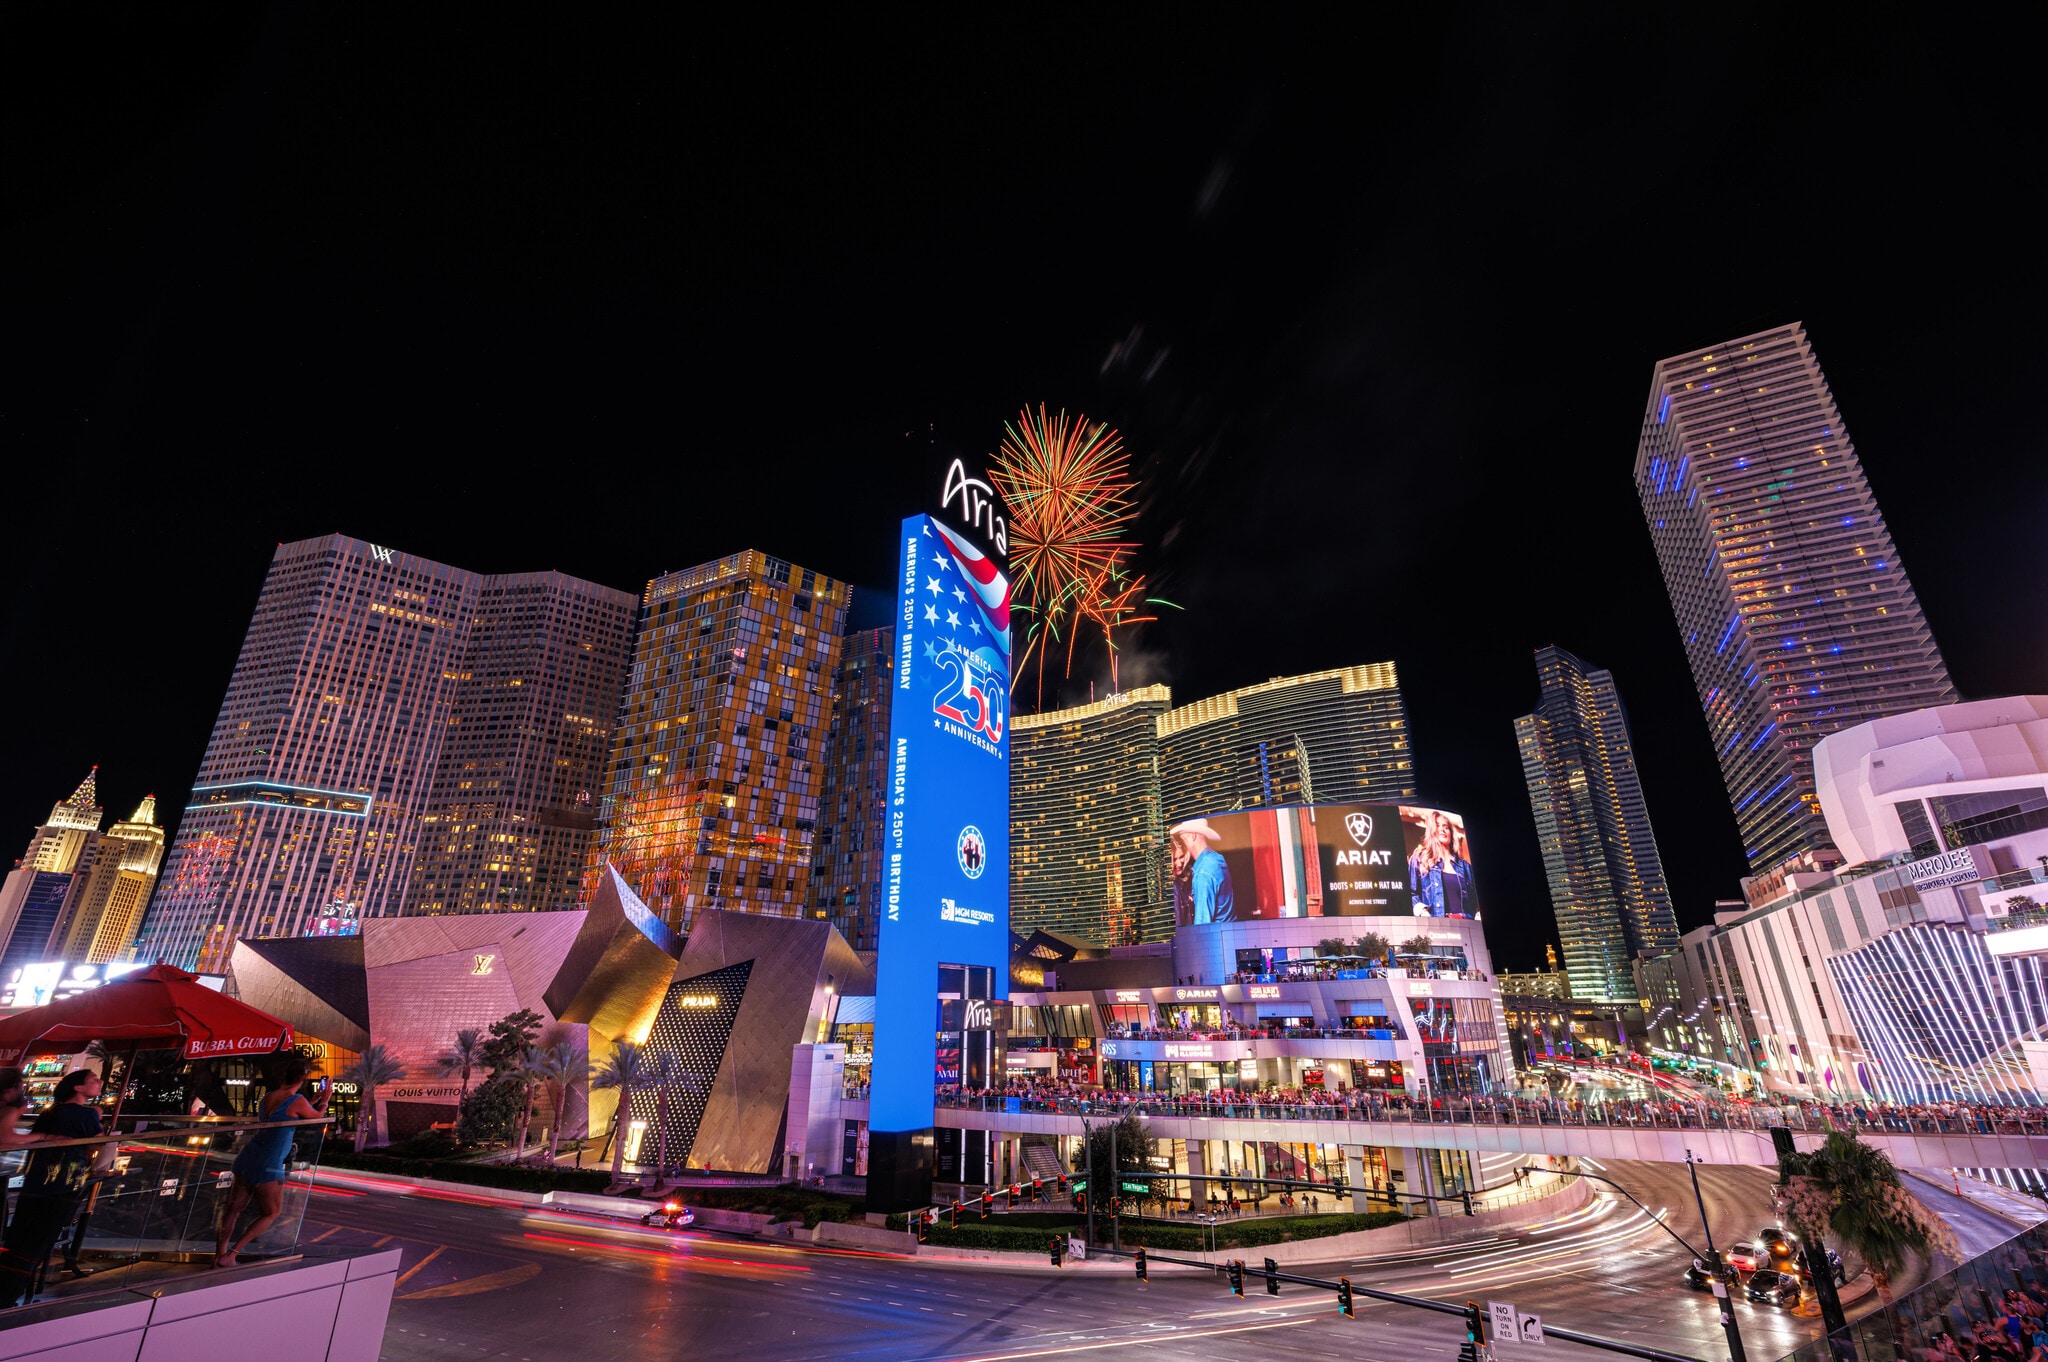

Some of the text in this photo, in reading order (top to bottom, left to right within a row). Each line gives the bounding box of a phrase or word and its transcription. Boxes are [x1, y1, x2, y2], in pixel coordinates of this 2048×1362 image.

[943, 459, 1007, 556] Aria
[905, 537, 917, 595] AMERICA'S
[900, 634, 912, 689] BIRTHDAY
[957, 643, 992, 673] AMERICA
[933, 650, 1004, 743] 250
[1104, 693, 1128, 709] Aria
[944, 721, 998, 757] ANNIVERSARY
[894, 738, 907, 806] AMERICA'S
[1336, 850, 1392, 866] ARIAT
[1907, 848, 1973, 880] MARQUEE
[888, 854, 901, 921] BIRTHDAY
[1329, 882, 1403, 891] BOOTS DENIM HAT BAR
[955, 907, 970, 918] MGM
[970, 909, 994, 923] RESORTS
[682, 996, 717, 1007] PRADA
[1187, 989, 1218, 998] ARIAT
[964, 1000, 992, 1030] Aria
[190, 1040, 235, 1054] BUBBA
[237, 1036, 279, 1049] GUMP
[0, 1048, 21, 1061] UMP
[332, 1082, 358, 1094] FORD
[393, 1088, 469, 1097] LOUIS VUITTO
[1495, 1306, 1508, 1314] NO
[1524, 1333, 1541, 1341] ONLY
